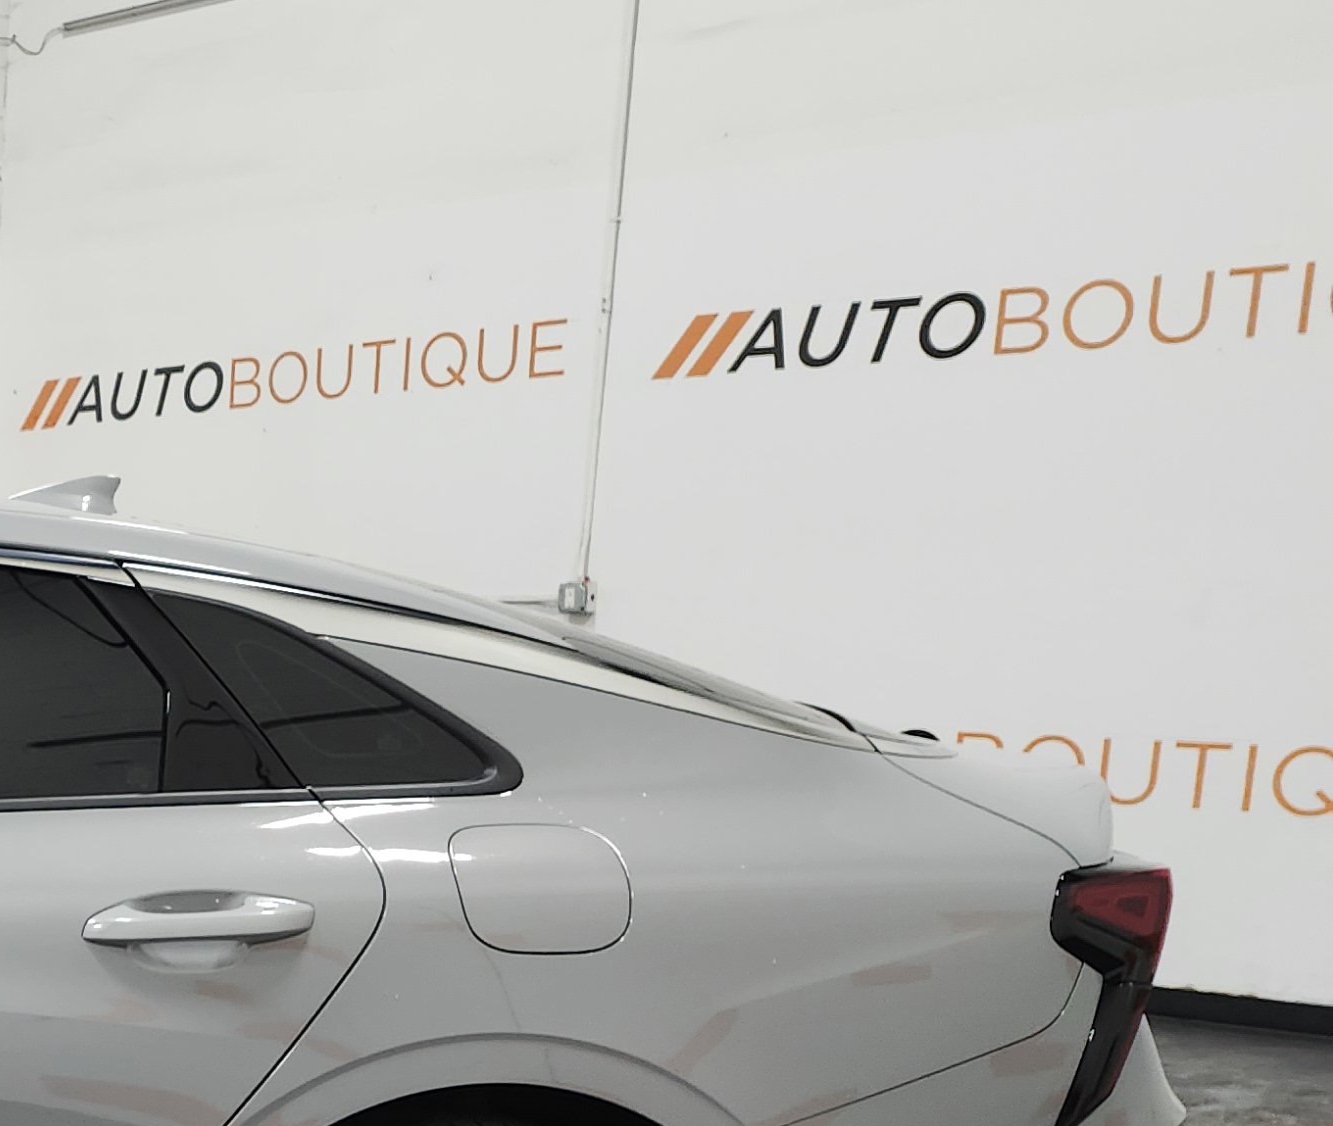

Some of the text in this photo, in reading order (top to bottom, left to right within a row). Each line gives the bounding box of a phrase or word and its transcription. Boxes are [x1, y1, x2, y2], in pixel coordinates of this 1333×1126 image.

[67, 317, 569, 426] AUTOBOUTIQUE
[726, 260, 1333, 375] AUTOBOUTI
[956, 730, 1333, 817] UTIQ
